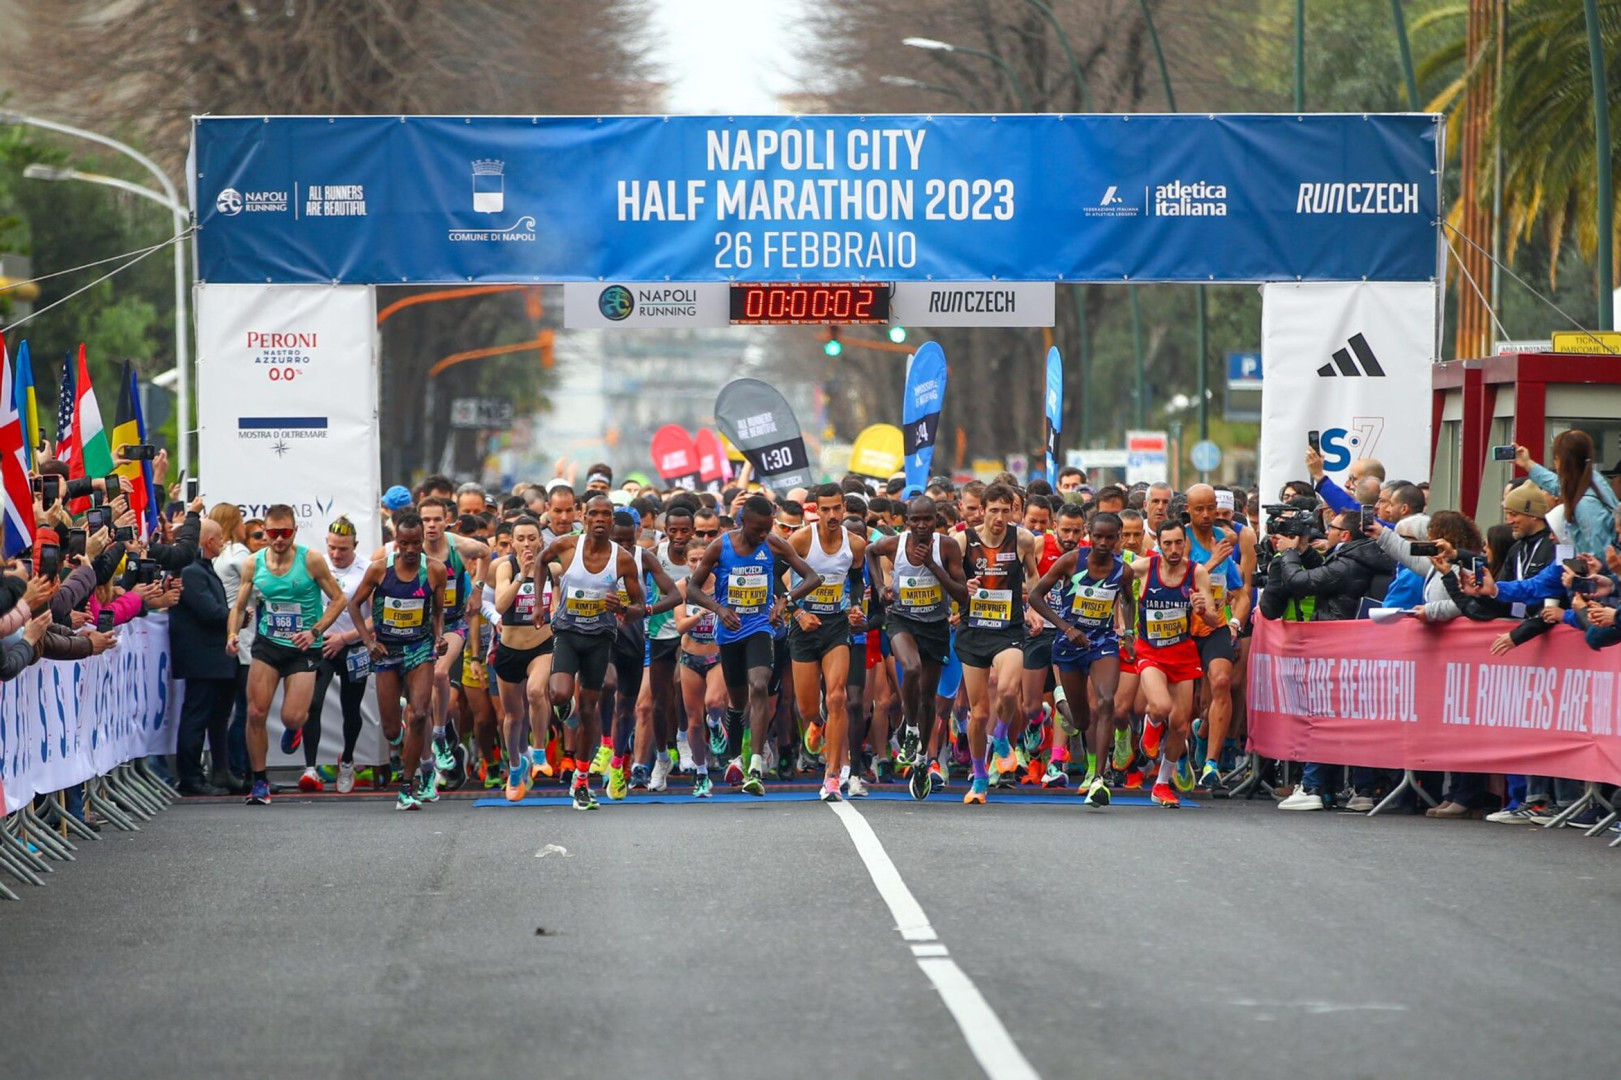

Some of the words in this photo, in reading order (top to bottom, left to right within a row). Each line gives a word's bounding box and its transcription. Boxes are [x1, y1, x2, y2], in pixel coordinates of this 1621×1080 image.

[706, 130, 834, 171] NAPOLI
[846, 129, 926, 171] CITY
[246, 192, 287, 202] NAPOLI
[308, 186, 322, 200] ALL
[324, 185, 364, 200] RUNNERS
[1155, 180, 1227, 199] atletica
[617, 180, 706, 221] HALF
[716, 180, 914, 221] MARATHON
[925, 178, 1016, 221] 2023
[1296, 183, 1418, 214] RUNCZECH
[246, 204, 287, 212] RUNNING
[306, 202, 322, 216] ARE
[324, 201, 367, 216] BEAUTIFUL
[1155, 197, 1227, 216] italiana
[448, 233, 488, 242] COMUNE
[491, 233, 500, 242] DI
[502, 233, 536, 242] NAPOLI
[714, 232, 752, 268] 26
[763, 231, 916, 268] FEBBRAIO
[639, 289, 696, 302] NAPOLI
[928, 290, 1016, 313] RUNCZECH
[746, 290, 873, 317] 00:00:02
[639, 306, 696, 317] RUNNING
[246, 332, 317, 348] PERONI
[1242, 358, 1257, 376] P
[238, 431, 271, 439] MOSTRA
[761, 446, 793, 471] 1:30
[729, 589, 748, 598] KIBET
[907, 590, 935, 599] MATATA
[974, 602, 1007, 612] CHEVRIER
[1081, 601, 1105, 611] WISLEY
[276, 617, 292, 627] 868
[1153, 623, 1161, 632] LA
[1164, 621, 1182, 631] ROSA
[1308, 658, 1336, 718] ARE
[1339, 658, 1418, 722] BEAUTIFUL
[1442, 662, 1470, 725] ALL
[1475, 663, 1557, 730] RUNNERS
[1556, 668, 1591, 732] ARE
